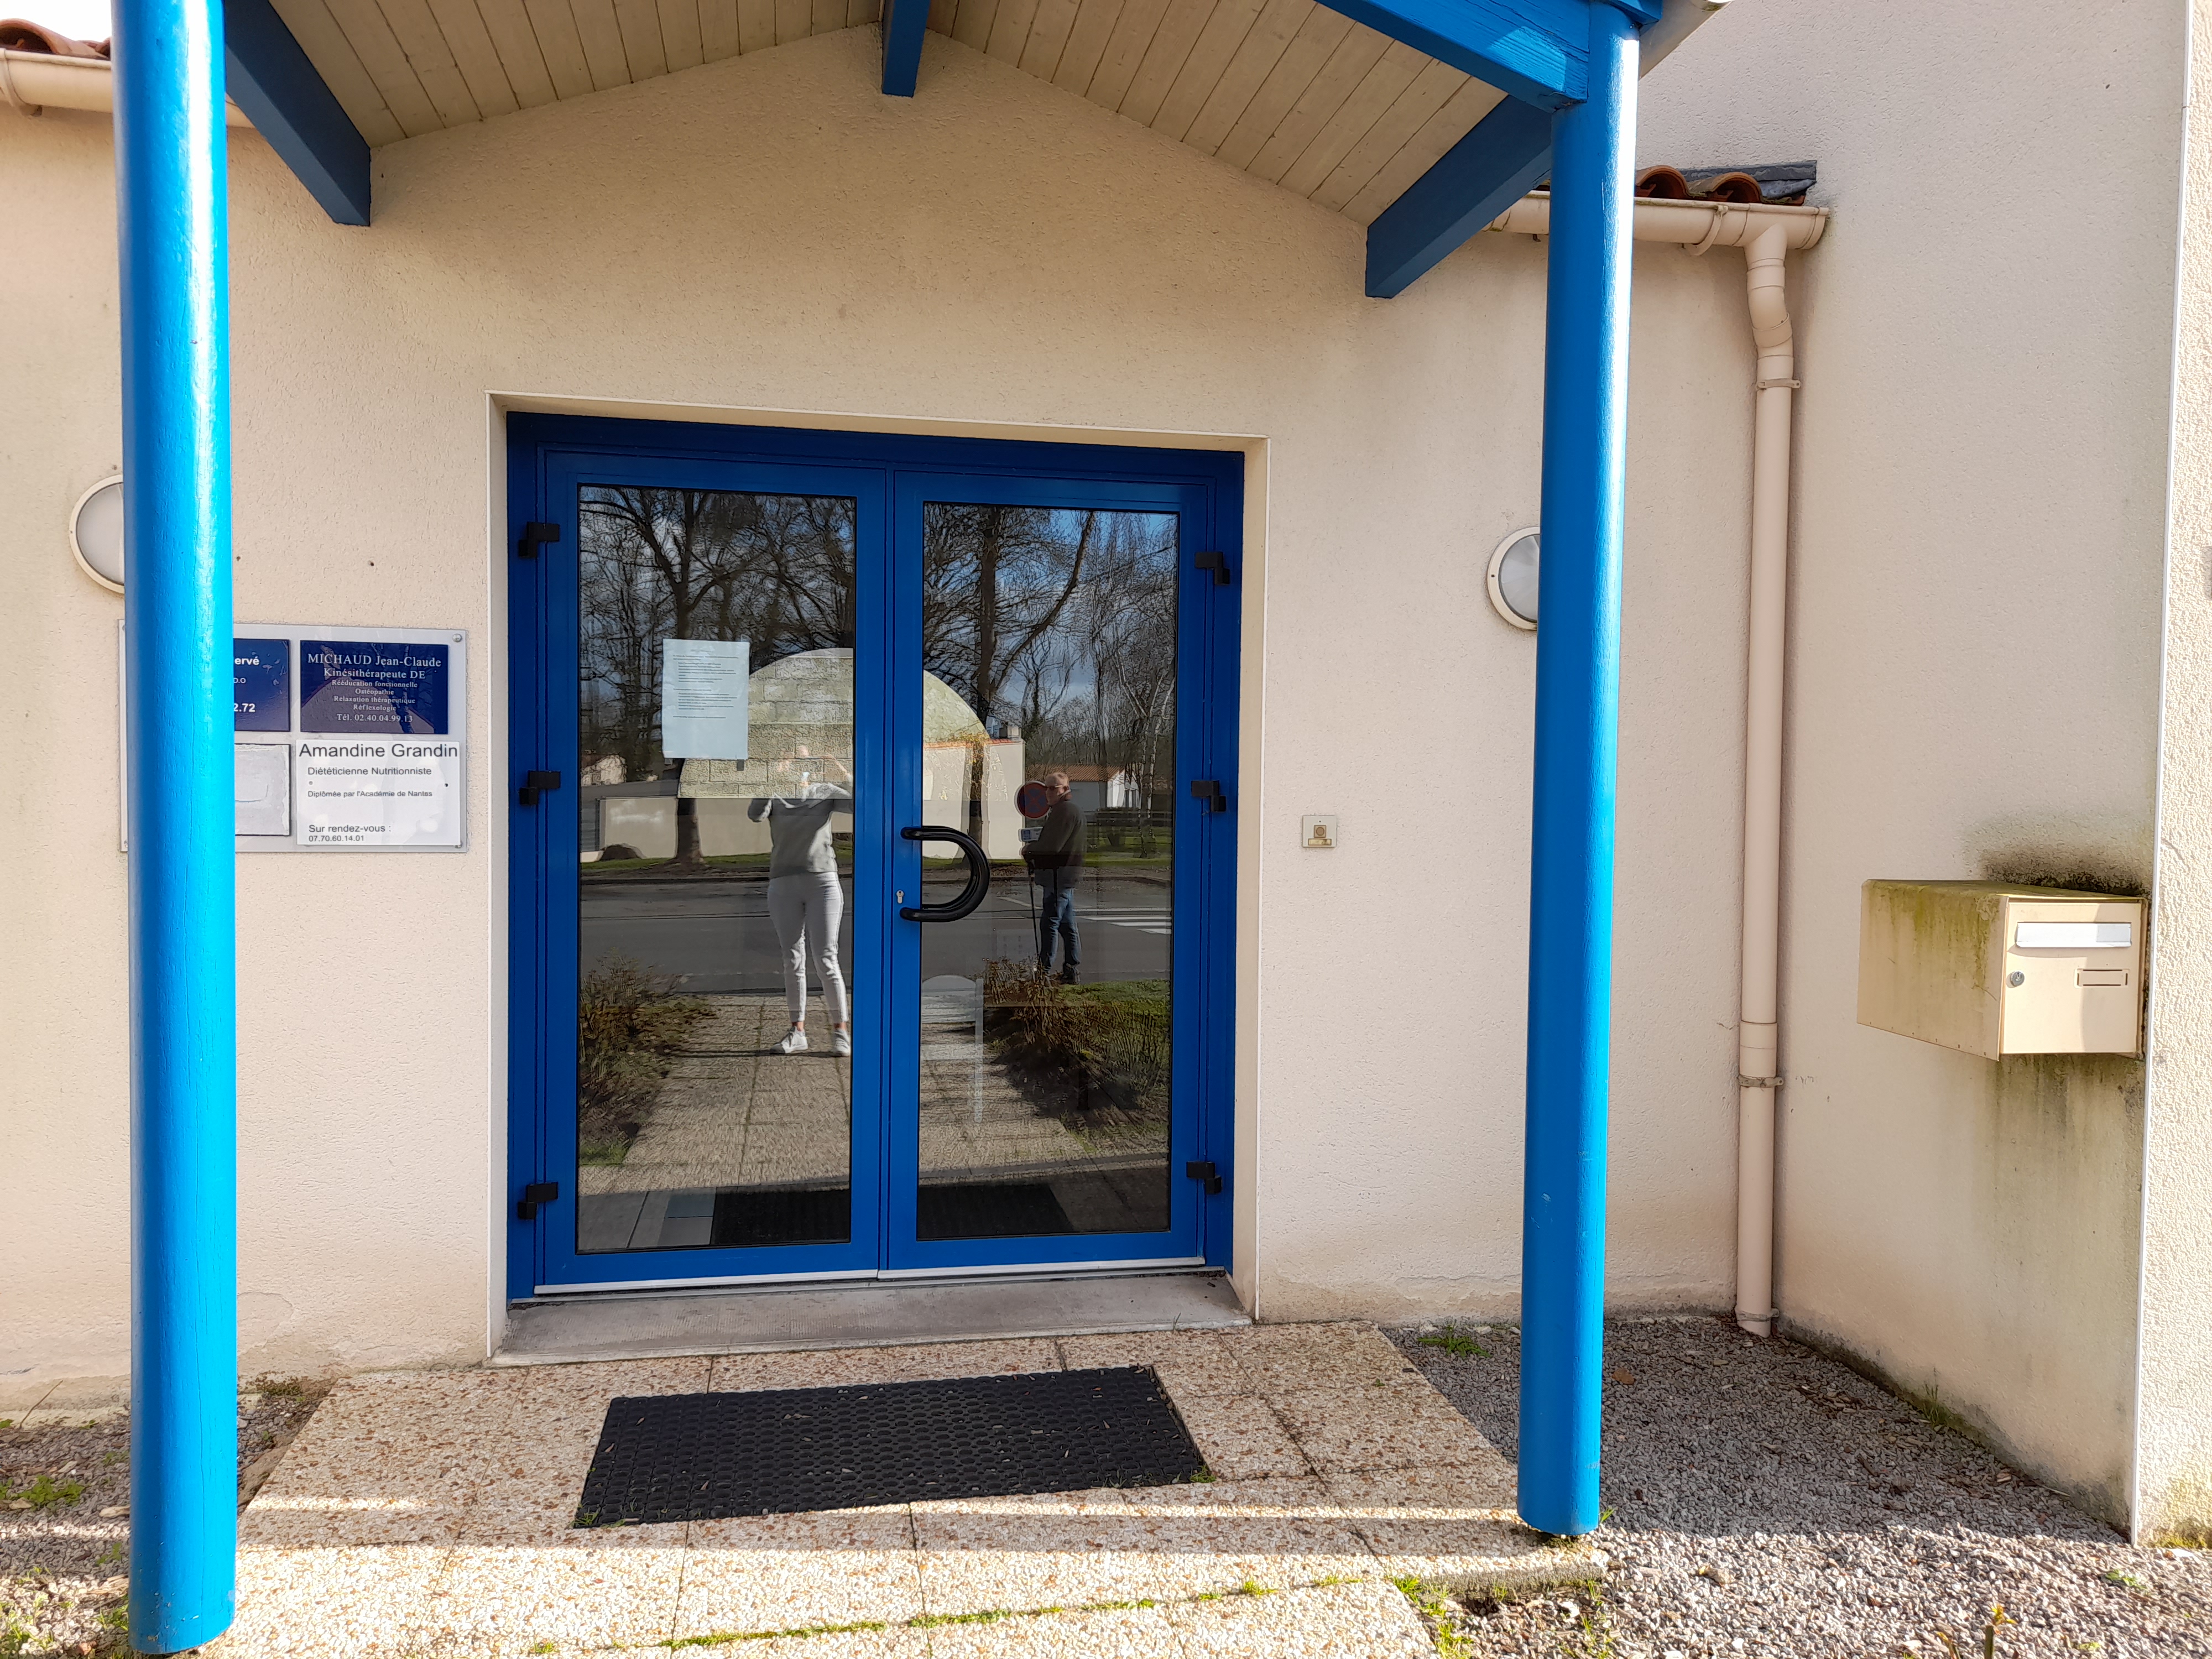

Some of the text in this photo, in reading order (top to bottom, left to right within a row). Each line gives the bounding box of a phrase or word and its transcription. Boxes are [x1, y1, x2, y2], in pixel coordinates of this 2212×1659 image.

[307, 653, 442, 667] MICHAUD Jean-Claude
[324, 667, 426, 680] Kinésithérapeute DE
[371, 697, 416, 705] thérapeutique
[353, 704, 397, 712] Réflexologie
[354, 714, 413, 722] 02.40.04.99.13
[299, 743, 457, 757] Amandine Grandin
[307, 767, 432, 775] Diététicienne Nutritionniste
